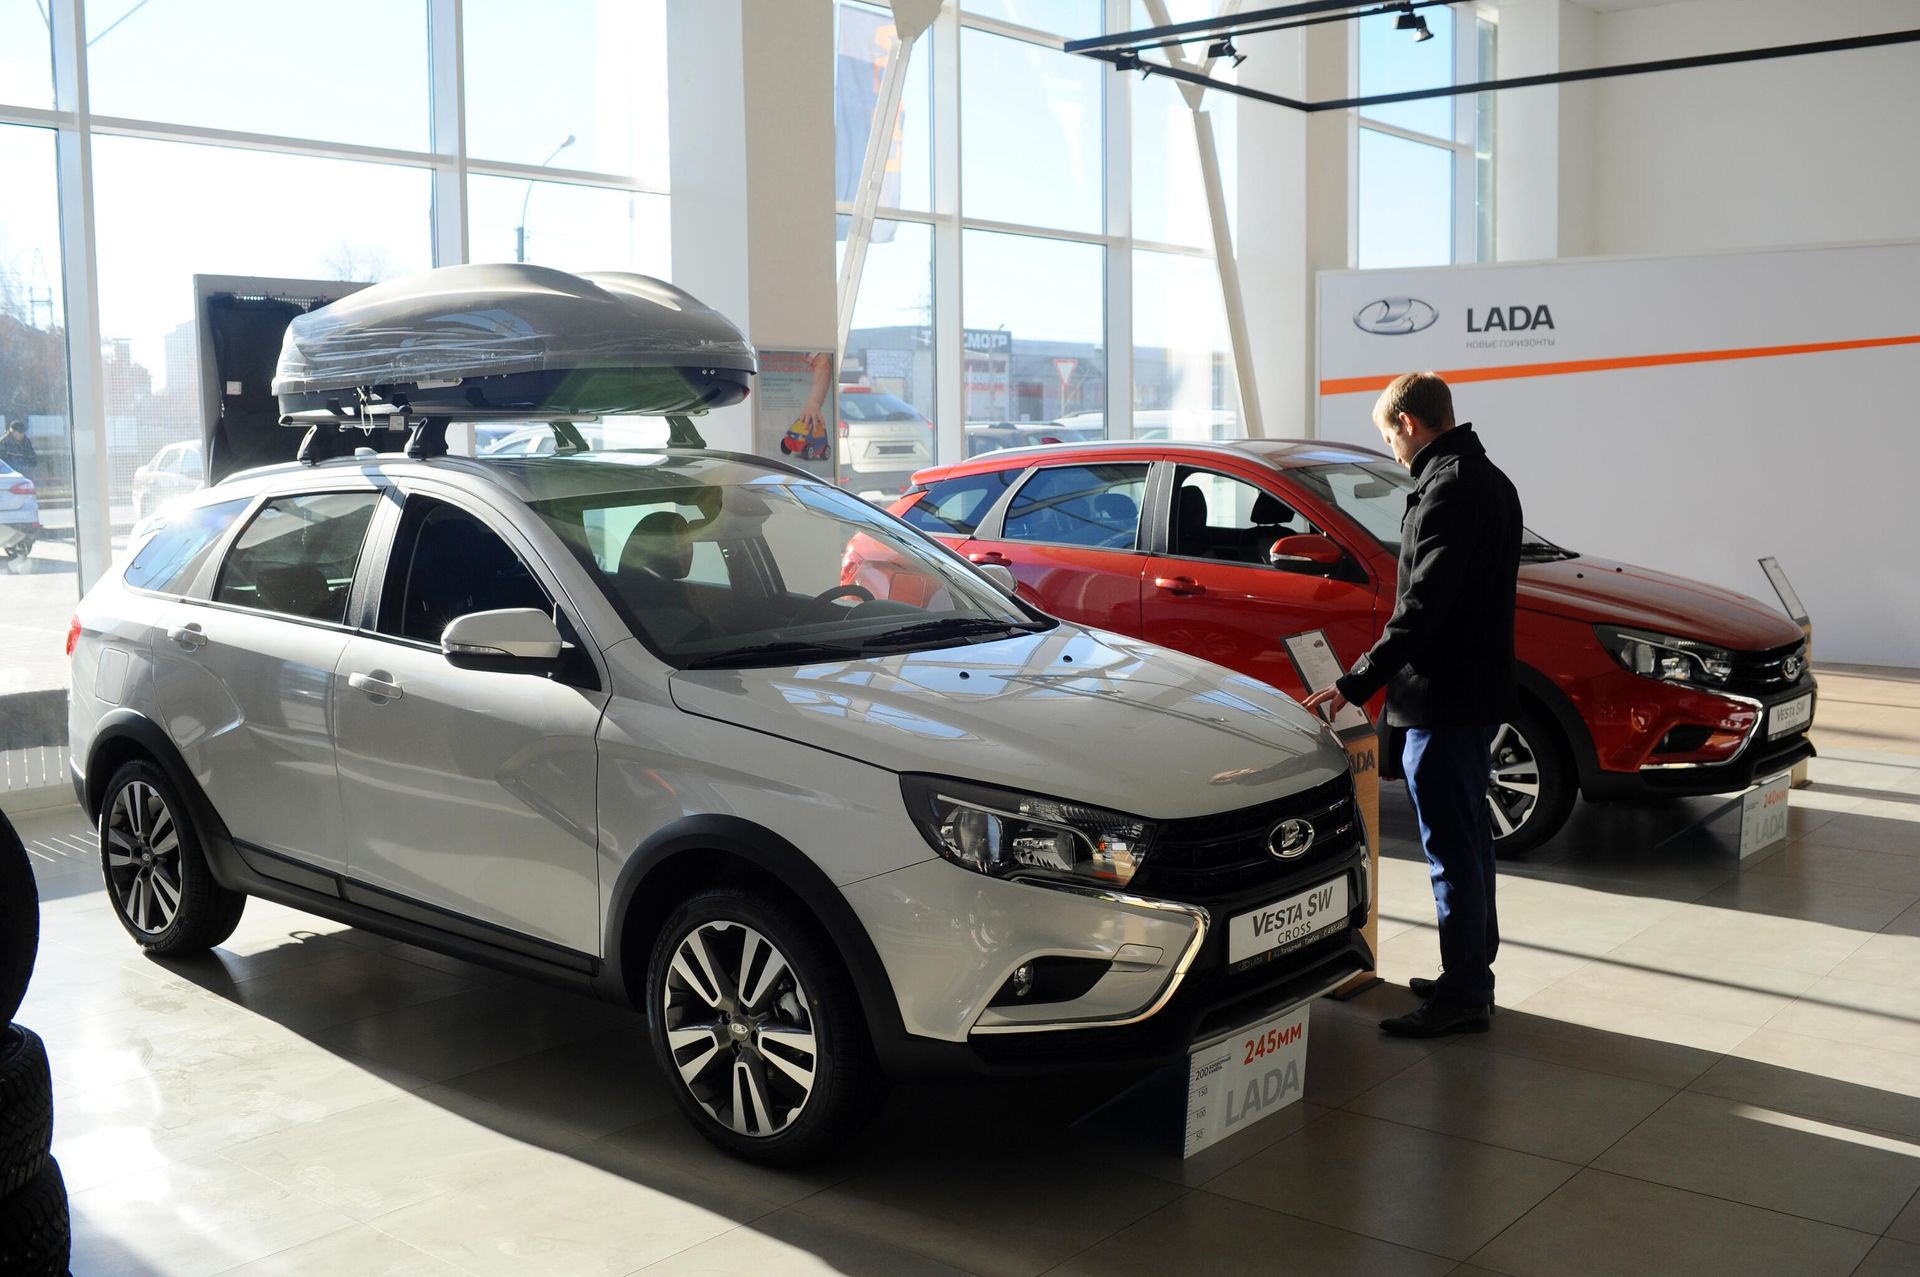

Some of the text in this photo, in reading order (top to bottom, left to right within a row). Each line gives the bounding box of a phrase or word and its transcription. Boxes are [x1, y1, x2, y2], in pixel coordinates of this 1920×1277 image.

[1467, 304, 1555, 333] LADA
[1466, 337, 1555, 349] НОВЫЕ ГОРИЗОНТЫ
[1349, 748, 1376, 774] ADA
[1755, 811, 1785, 844] LADA
[1252, 886, 1334, 937] VESTA SW
[1277, 921, 1312, 944] CROSS
[1195, 1065, 1209, 1081] 200
[1198, 1087, 1208, 1098] 150
[1225, 1058, 1300, 1128] LADA
[1195, 1109, 1207, 1120] 100
[1195, 1131, 1204, 1141] 50
